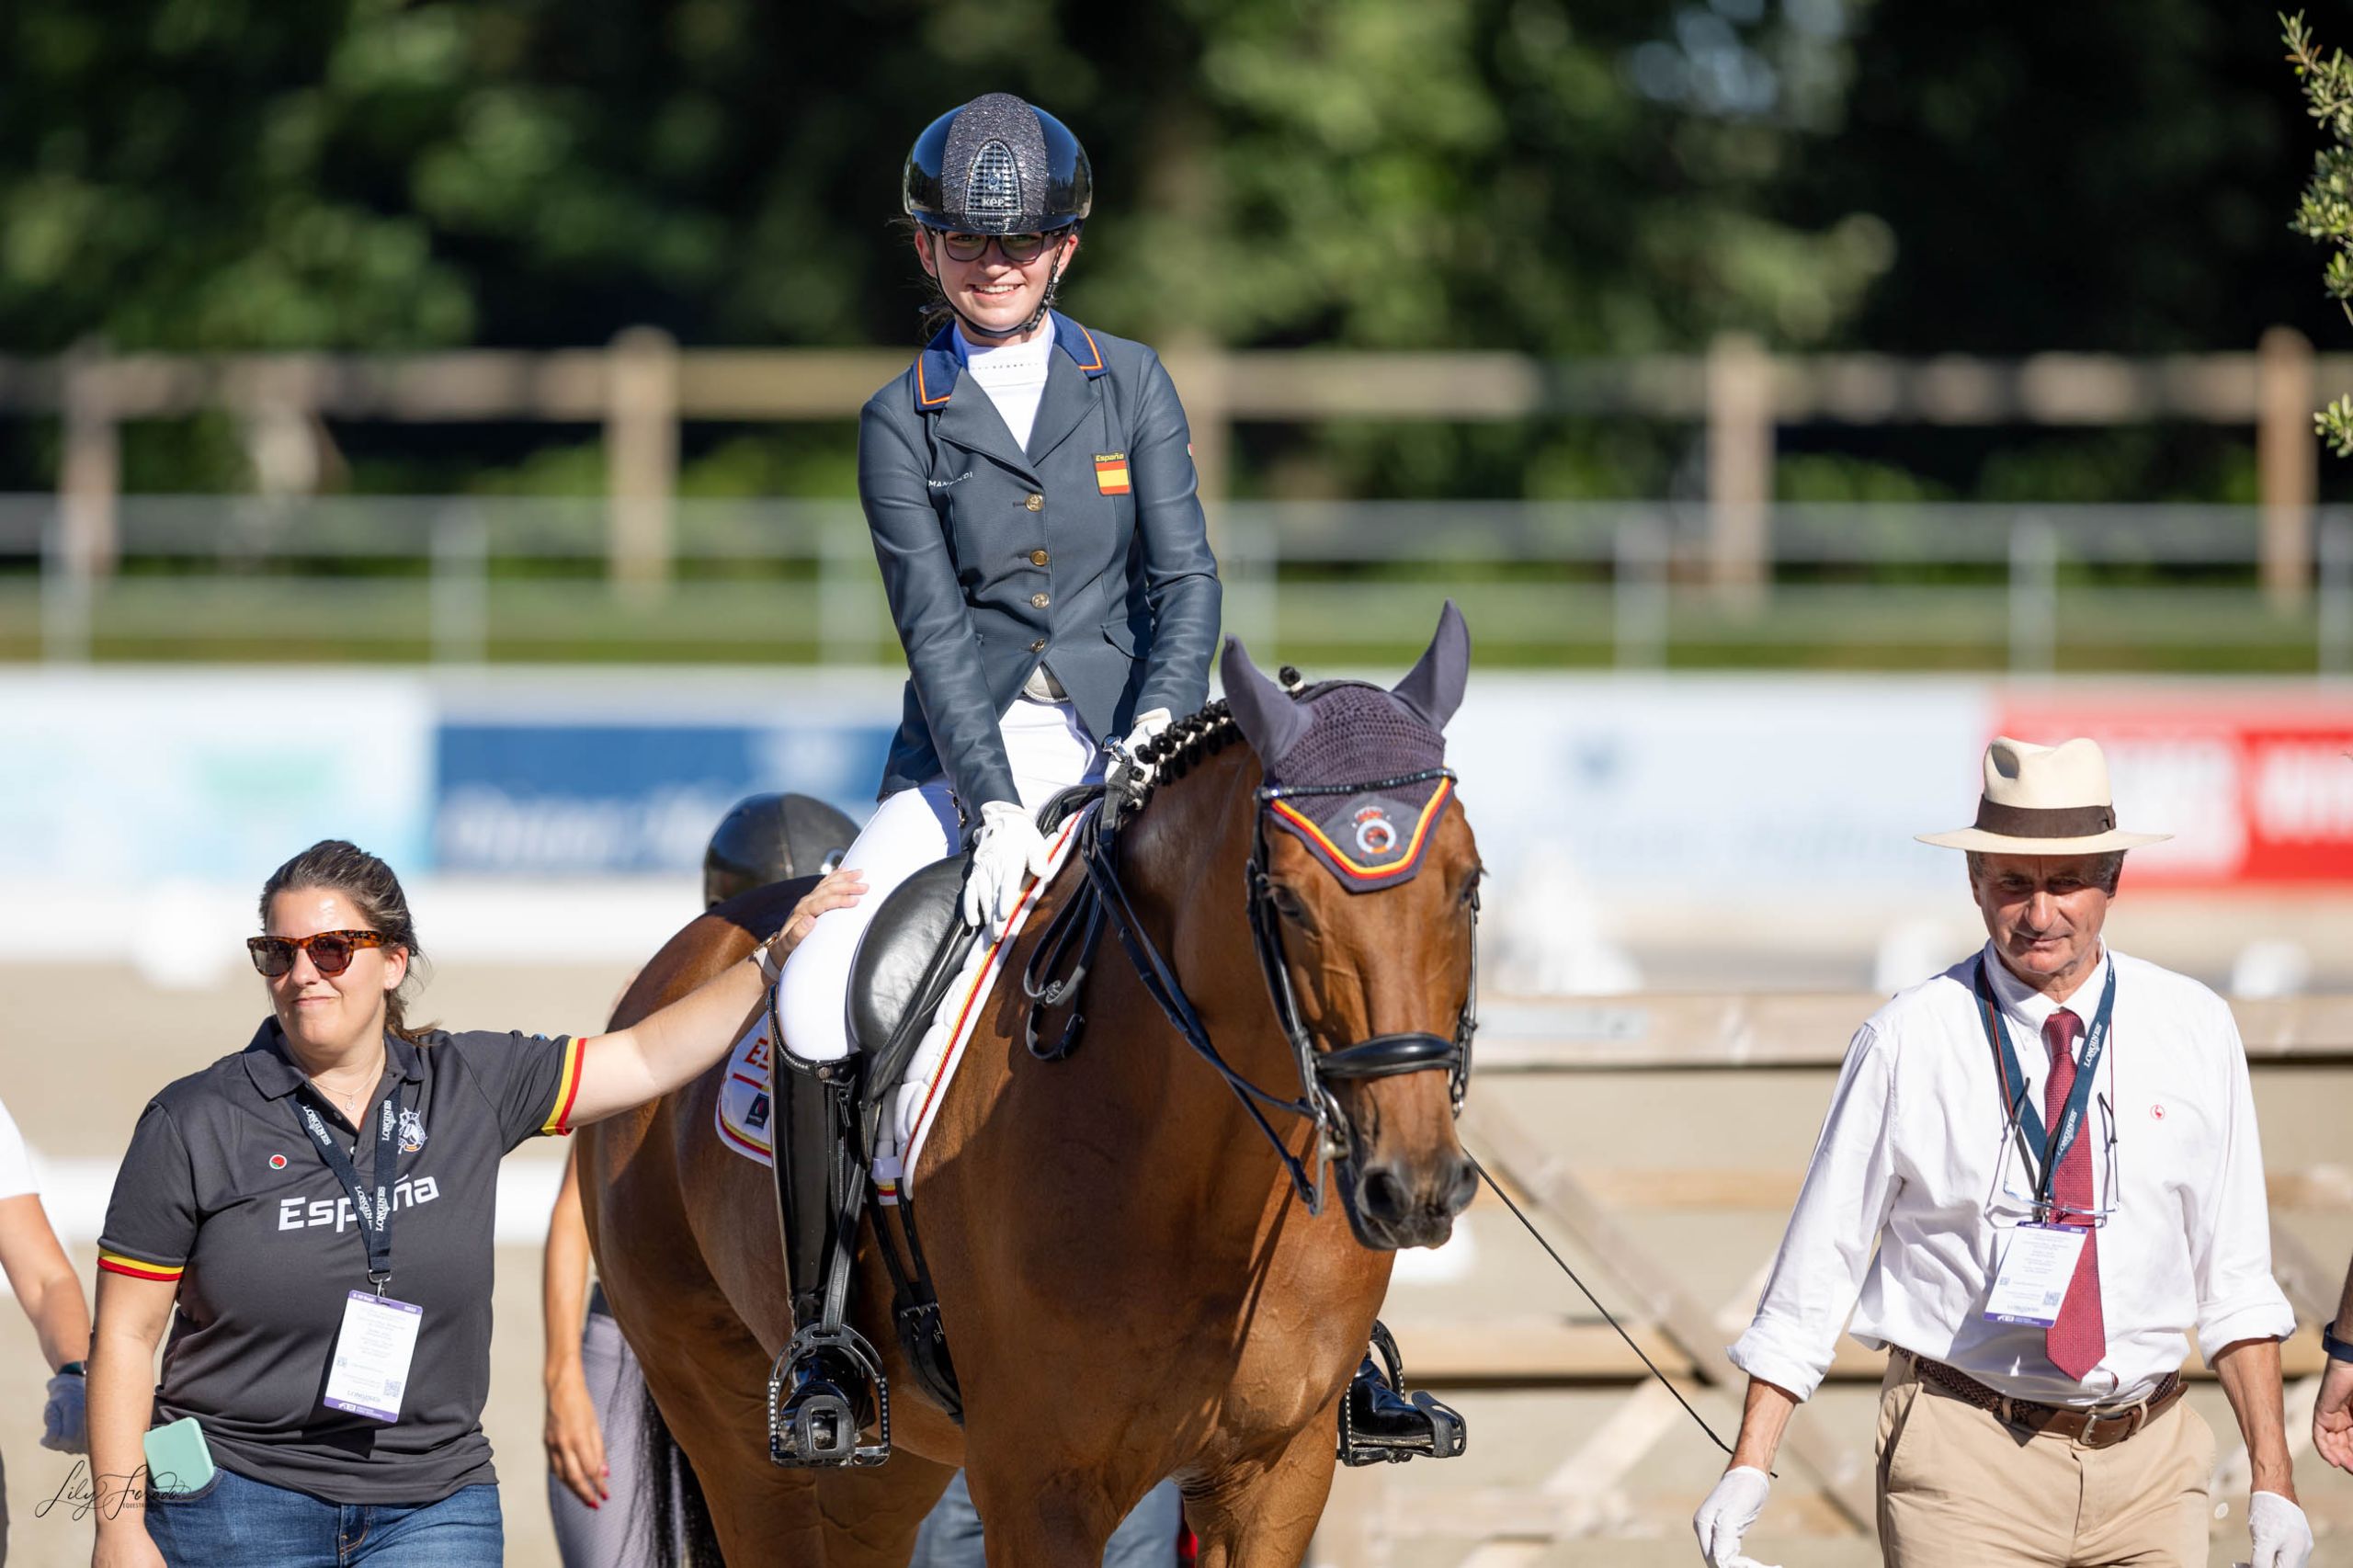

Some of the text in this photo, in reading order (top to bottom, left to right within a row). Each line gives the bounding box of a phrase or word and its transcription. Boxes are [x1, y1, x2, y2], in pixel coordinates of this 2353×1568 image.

[2083, 1021, 2103, 1068] LONGINES
[302, 1105, 332, 1146] LONGINES
[381, 1099, 392, 1142] LONGINES
[2057, 1108, 2077, 1156] LONGINES
[278, 1174, 440, 1233] Espña
[354, 1185, 372, 1230] LONGIN
[375, 1186, 388, 1233] LONGINES
